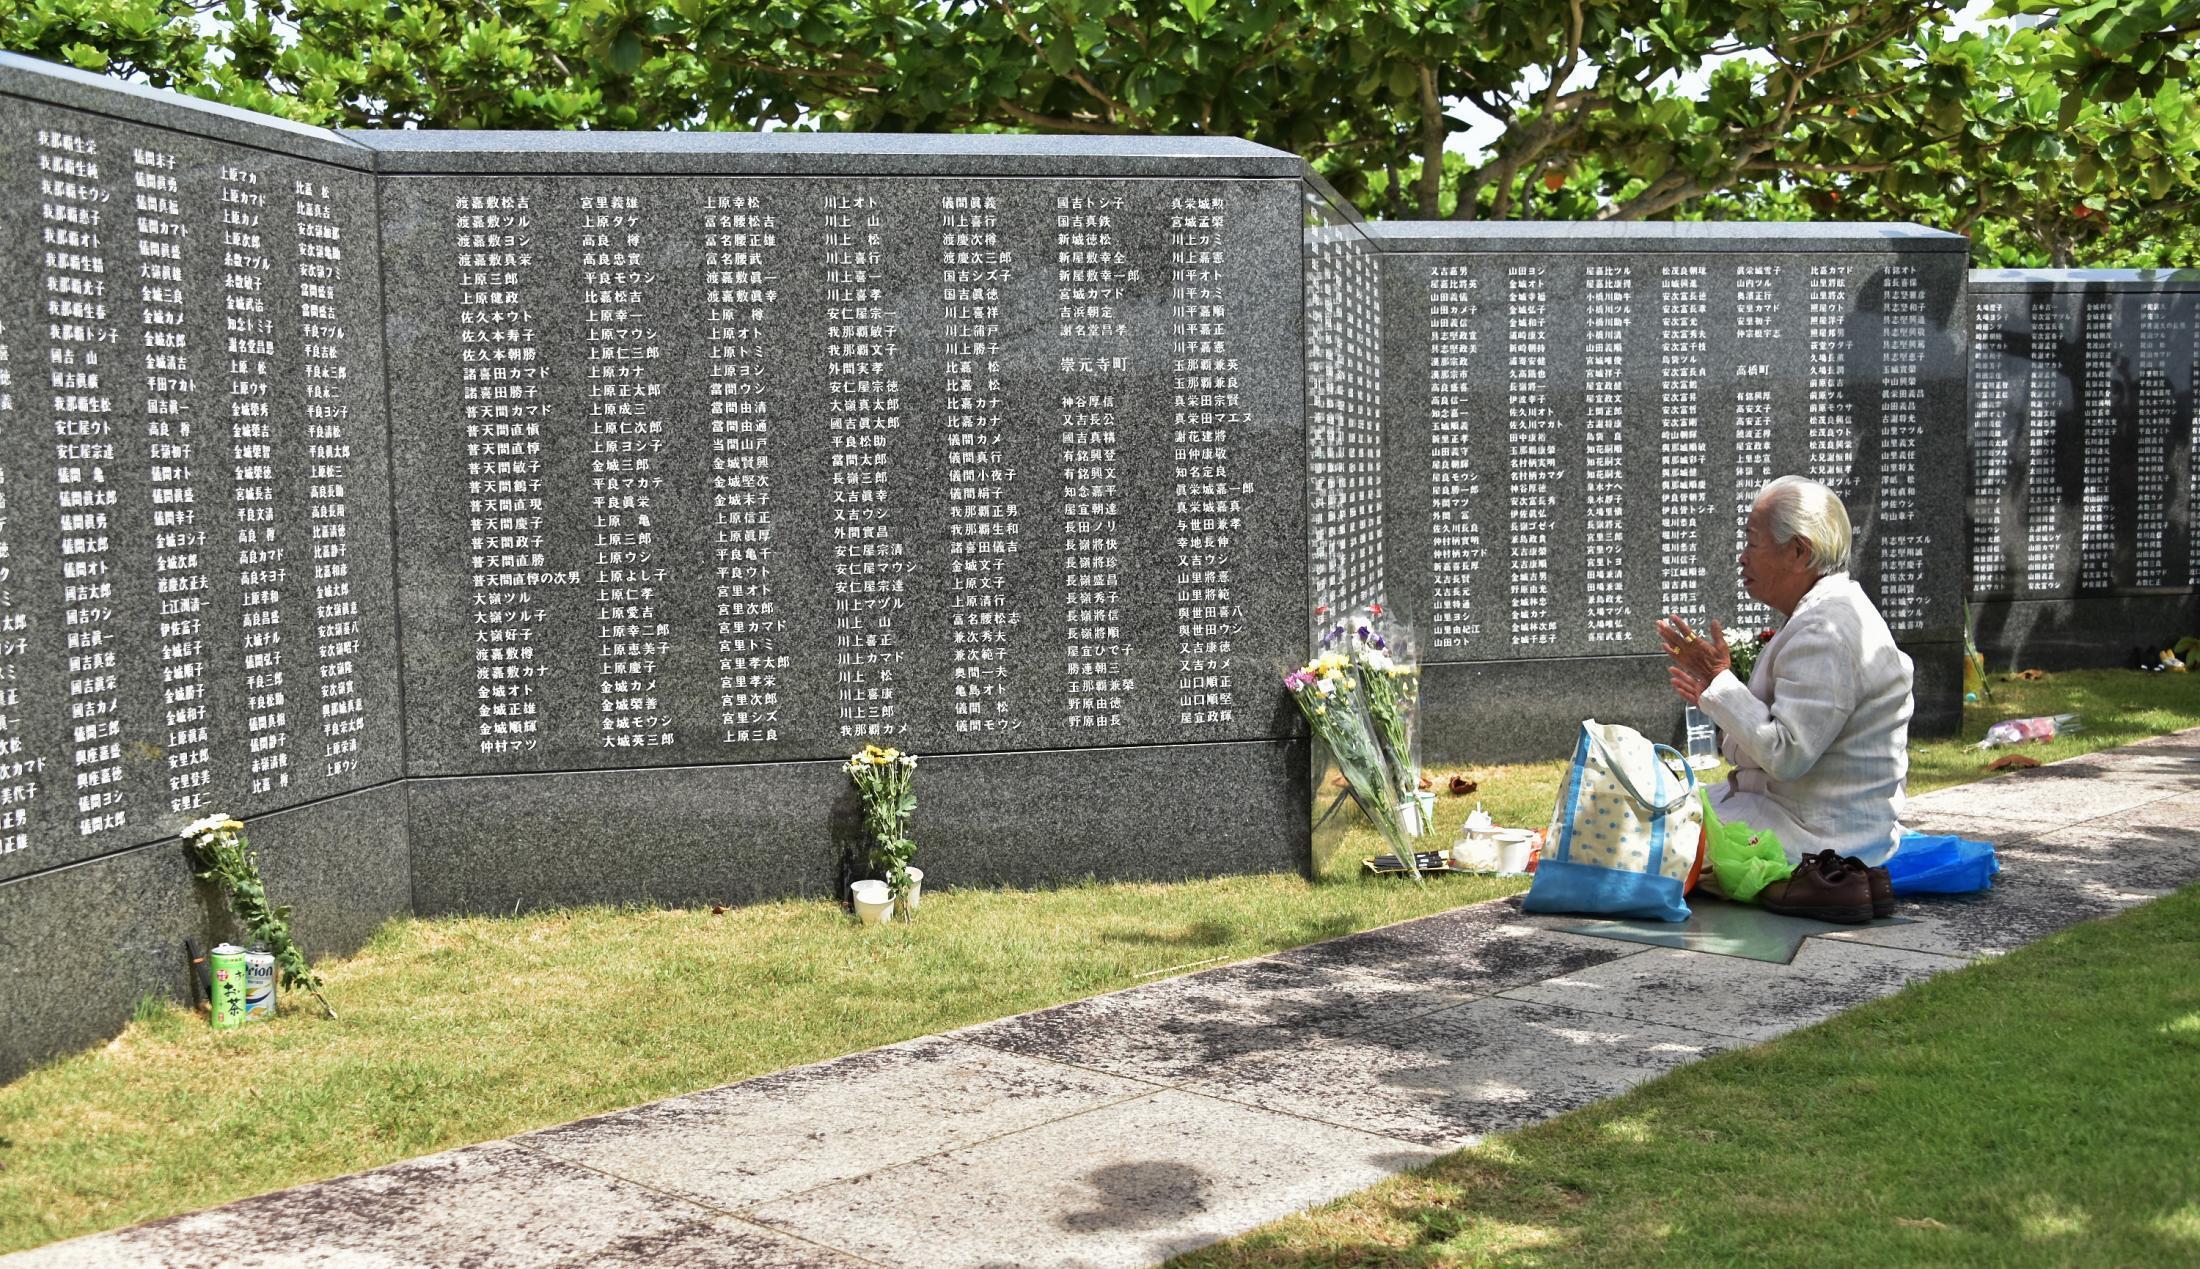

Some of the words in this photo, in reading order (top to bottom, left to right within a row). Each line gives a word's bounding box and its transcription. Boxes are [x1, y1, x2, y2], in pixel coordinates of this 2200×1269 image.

[580, 195, 638, 209] 宮里義雄
[703, 196, 760, 209] 上原幸松
[823, 196, 877, 209] 川上オト
[456, 214, 530, 228] 渡嘉敷ツル
[582, 214, 639, 228] 上原タケ
[942, 214, 997, 228] 川上喜行
[456, 233, 530, 247] 渡嘉敷ヨシ
[1172, 232, 1222, 245] 川上カミ
[826, 251, 881, 264] 川上喜行
[943, 251, 1012, 264] 渡慶次三郎
[459, 272, 518, 286] 上原三郎
[584, 271, 654, 284] 平良モウシ
[826, 269, 881, 283] 川上喜一
[943, 269, 1011, 282] 国吉シズ子
[1172, 269, 1222, 281] 川平オト
[585, 290, 642, 303] 比嘉松吉
[1059, 287, 1124, 300] 宮城カマド
[1172, 286, 1222, 300] 川平カミ
[461, 310, 532, 323] 佐久本ウト
[585, 308, 642, 322] 上原幸一
[1059, 305, 1113, 318] 吉浜朝定
[461, 328, 535, 342] 佐久本寿子
[586, 328, 657, 341] 上原マウシ
[708, 326, 762, 340] 上原オト
[1173, 322, 1225, 335] 川平嘉正
[587, 345, 659, 360] 上原仁三郎
[709, 345, 763, 359] 上原トミ
[945, 342, 1000, 355] 川上勝子
[588, 365, 644, 378] 上原カナ
[710, 364, 764, 377] 上原ヨシ
[1060, 356, 1128, 373] 崇元寺町
[588, 383, 661, 397] 上原正太郎
[947, 396, 1001, 410] 比嘉カナ
[465, 404, 551, 418] 普天間カマド
[713, 437, 767, 451] 当間山戸
[831, 434, 886, 448] 平良松助
[949, 468, 1016, 482] 儀間小夜子
[1175, 464, 1226, 478] 知名定良
[833, 508, 887, 521] 又吉ウシ
[950, 504, 1018, 518] 我那覇正男
[1064, 520, 1115, 533] 長田ノリ
[1176, 535, 1229, 548] 幸地長伸
[595, 551, 651, 565] 上原ウシ
[951, 558, 1005, 572] 金城文子
[1178, 553, 1227, 566] 又吉ウシ
[595, 568, 667, 583] 上原よし子
[835, 561, 917, 576] 安仁屋マウシ
[717, 583, 770, 597] 宮里オト
[952, 576, 1005, 590] 上原文子
[717, 601, 774, 616] 宮里次郎
[598, 623, 670, 638] 上原幸二郎
[718, 620, 786, 634] 宮里カマド
[837, 633, 891, 647] 川上喜正
[598, 641, 670, 656] 上原恵美子
[1067, 643, 1134, 657] 屋宜ひで子
[719, 655, 790, 670] 宮里孝太郎
[838, 651, 904, 665] 川上カマド
[1179, 658, 1230, 671] 又吉カメ
[954, 665, 1007, 679] 奥間一夫
[1067, 661, 1119, 675] 勝連朝三
[1179, 675, 1231, 689] 山口順正
[477, 684, 532, 699] 金城オト
[722, 710, 778, 725] 宮里シズ
[839, 705, 894, 719] 川上三郎
[955, 718, 1022, 732] 儀間モウシ
[1068, 714, 1121, 727] 野原由長
[723, 728, 777, 743] 上原三良
[840, 722, 907, 736] 我那覇カメ
[480, 739, 537, 753] 仲村マツ
[602, 732, 674, 747] 大城英三郎
[246, 964, 273, 976] rion
[223, 982, 243, 1016] お茶
